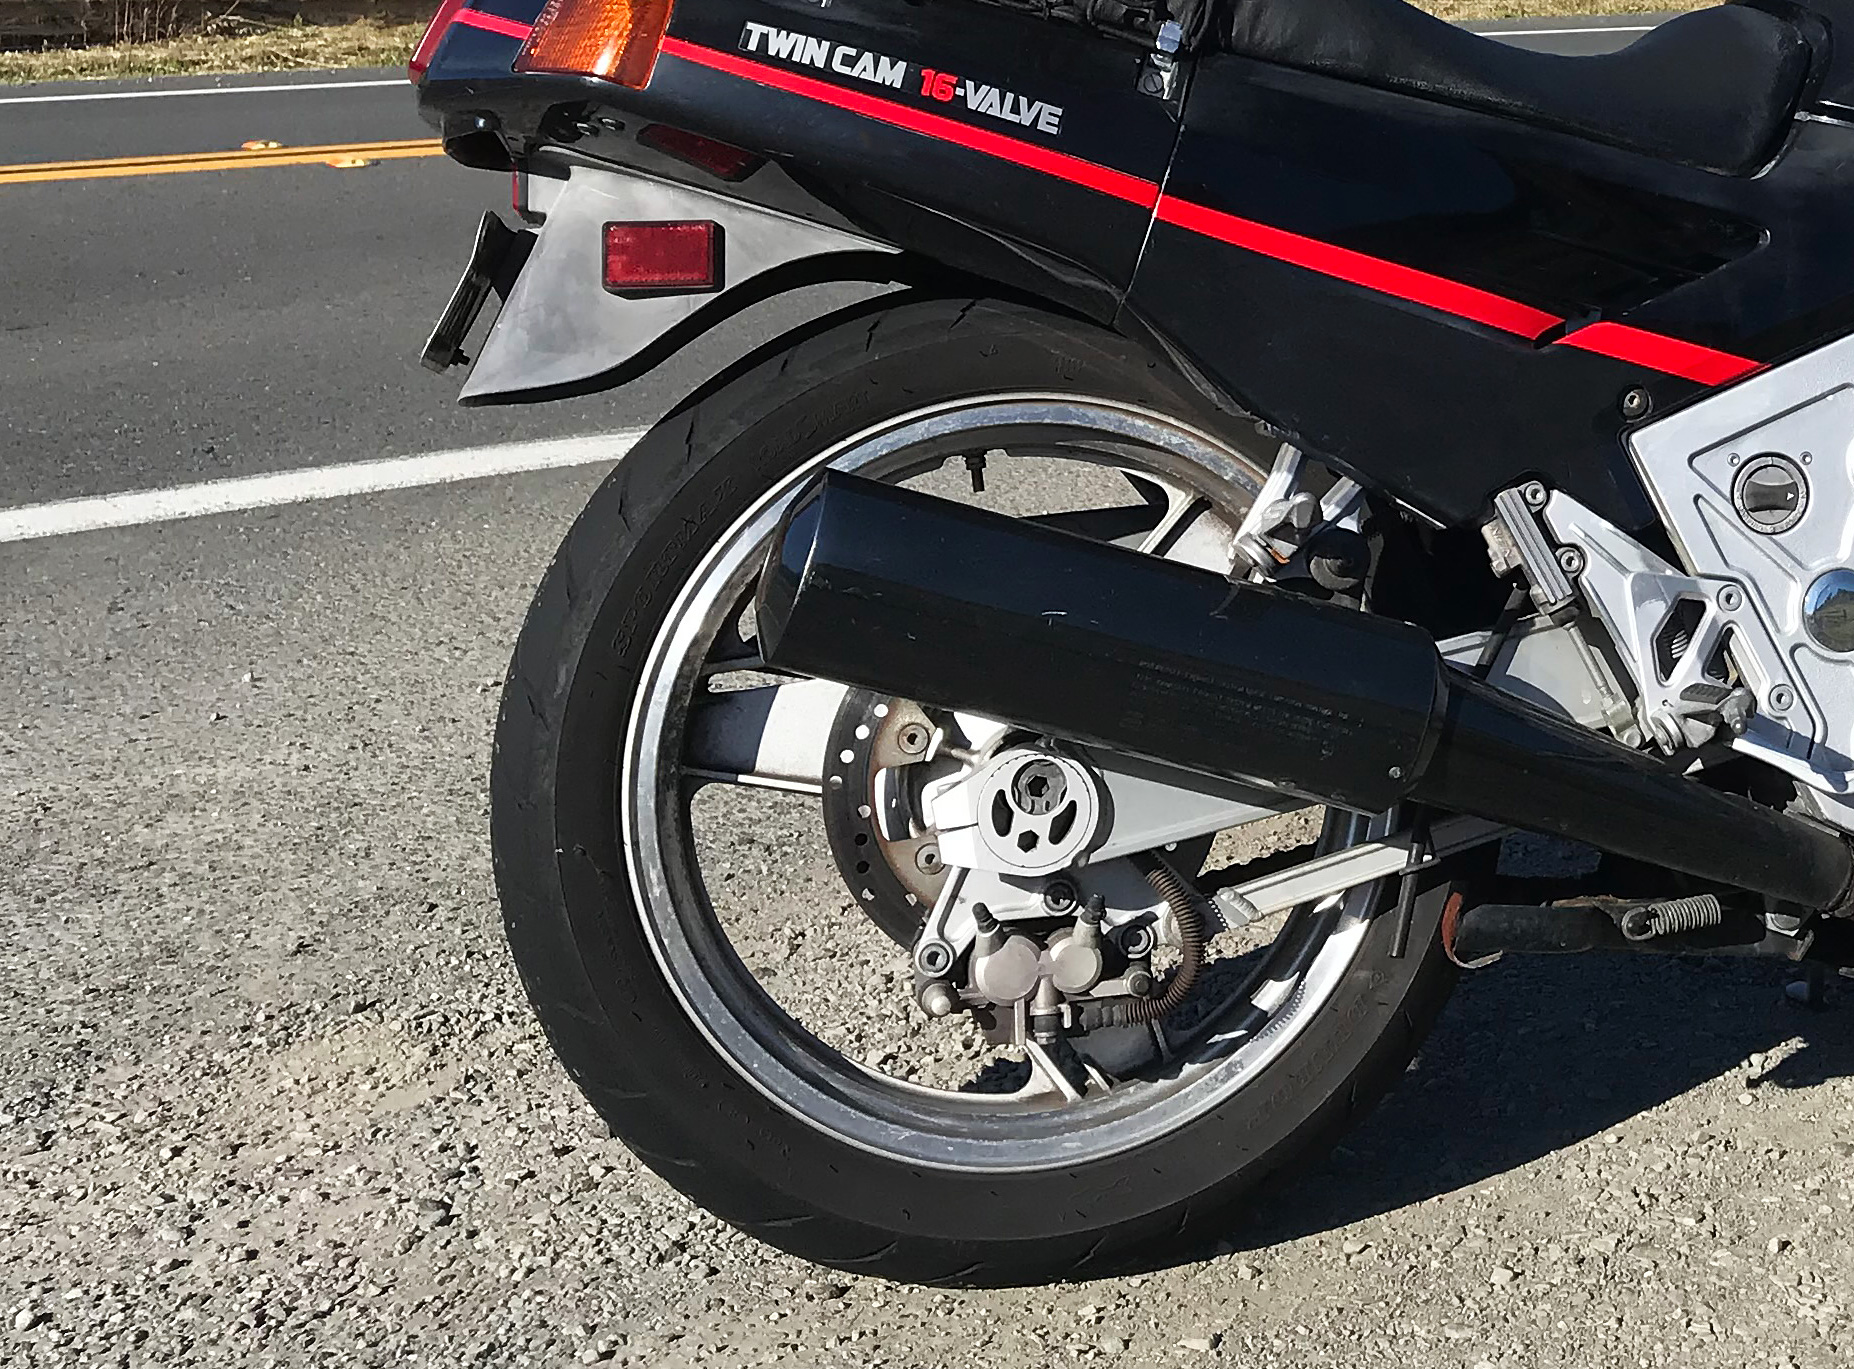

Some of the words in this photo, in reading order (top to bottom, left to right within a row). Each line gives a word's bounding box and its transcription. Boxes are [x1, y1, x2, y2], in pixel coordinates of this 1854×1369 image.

[746, 21, 831, 69] TWIN
[831, 45, 907, 88] CAM
[920, 68, 1064, 135] 16-VALVE
